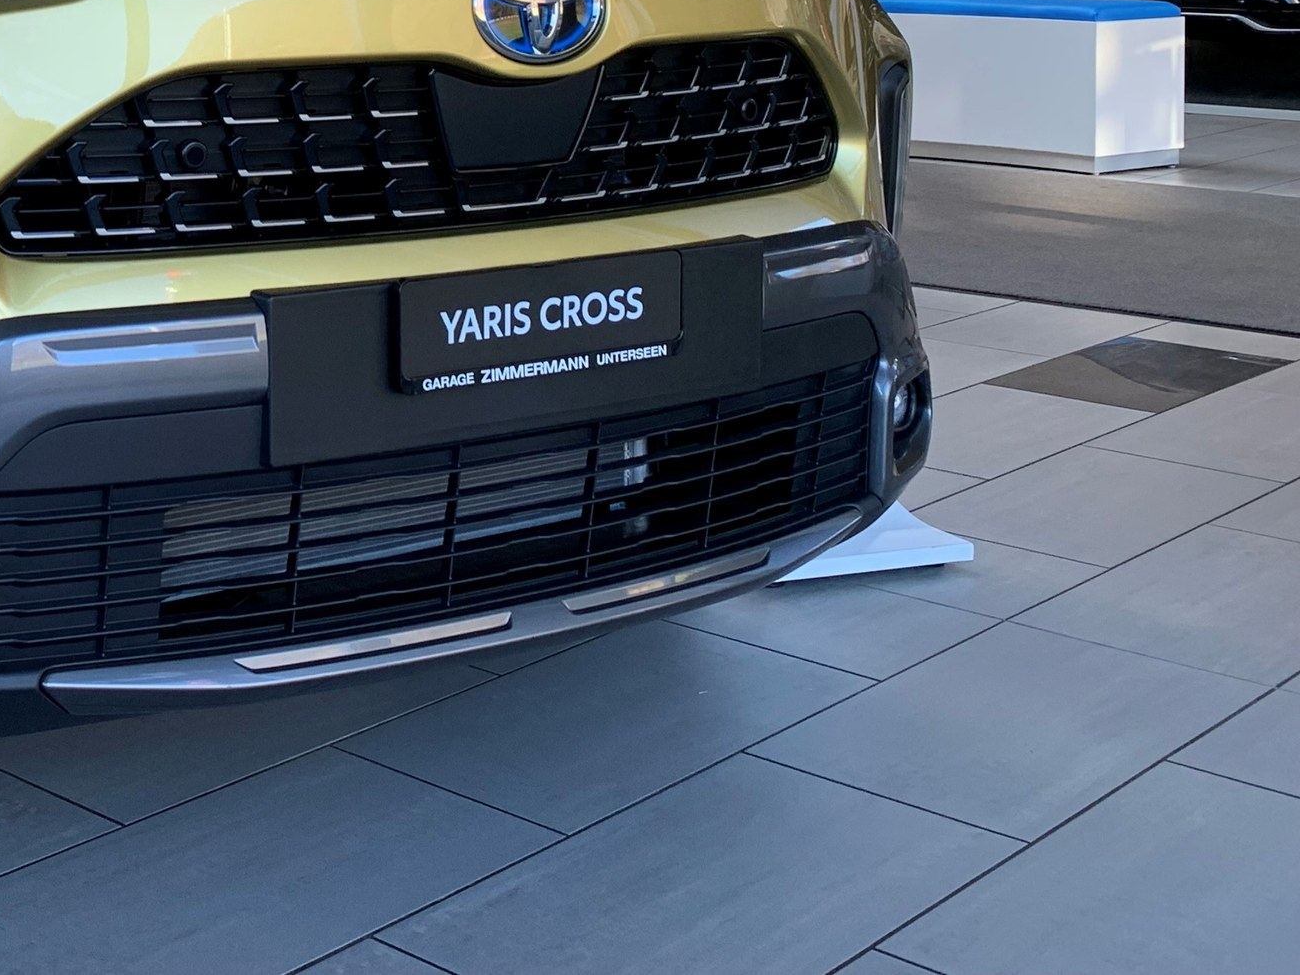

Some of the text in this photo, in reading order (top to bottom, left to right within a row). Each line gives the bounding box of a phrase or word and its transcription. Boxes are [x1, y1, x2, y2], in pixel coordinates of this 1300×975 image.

[439, 286, 645, 345] YARIS CROSS
[422, 344, 668, 391] GARAGE ZIMMERMANN UNTERSEEN
